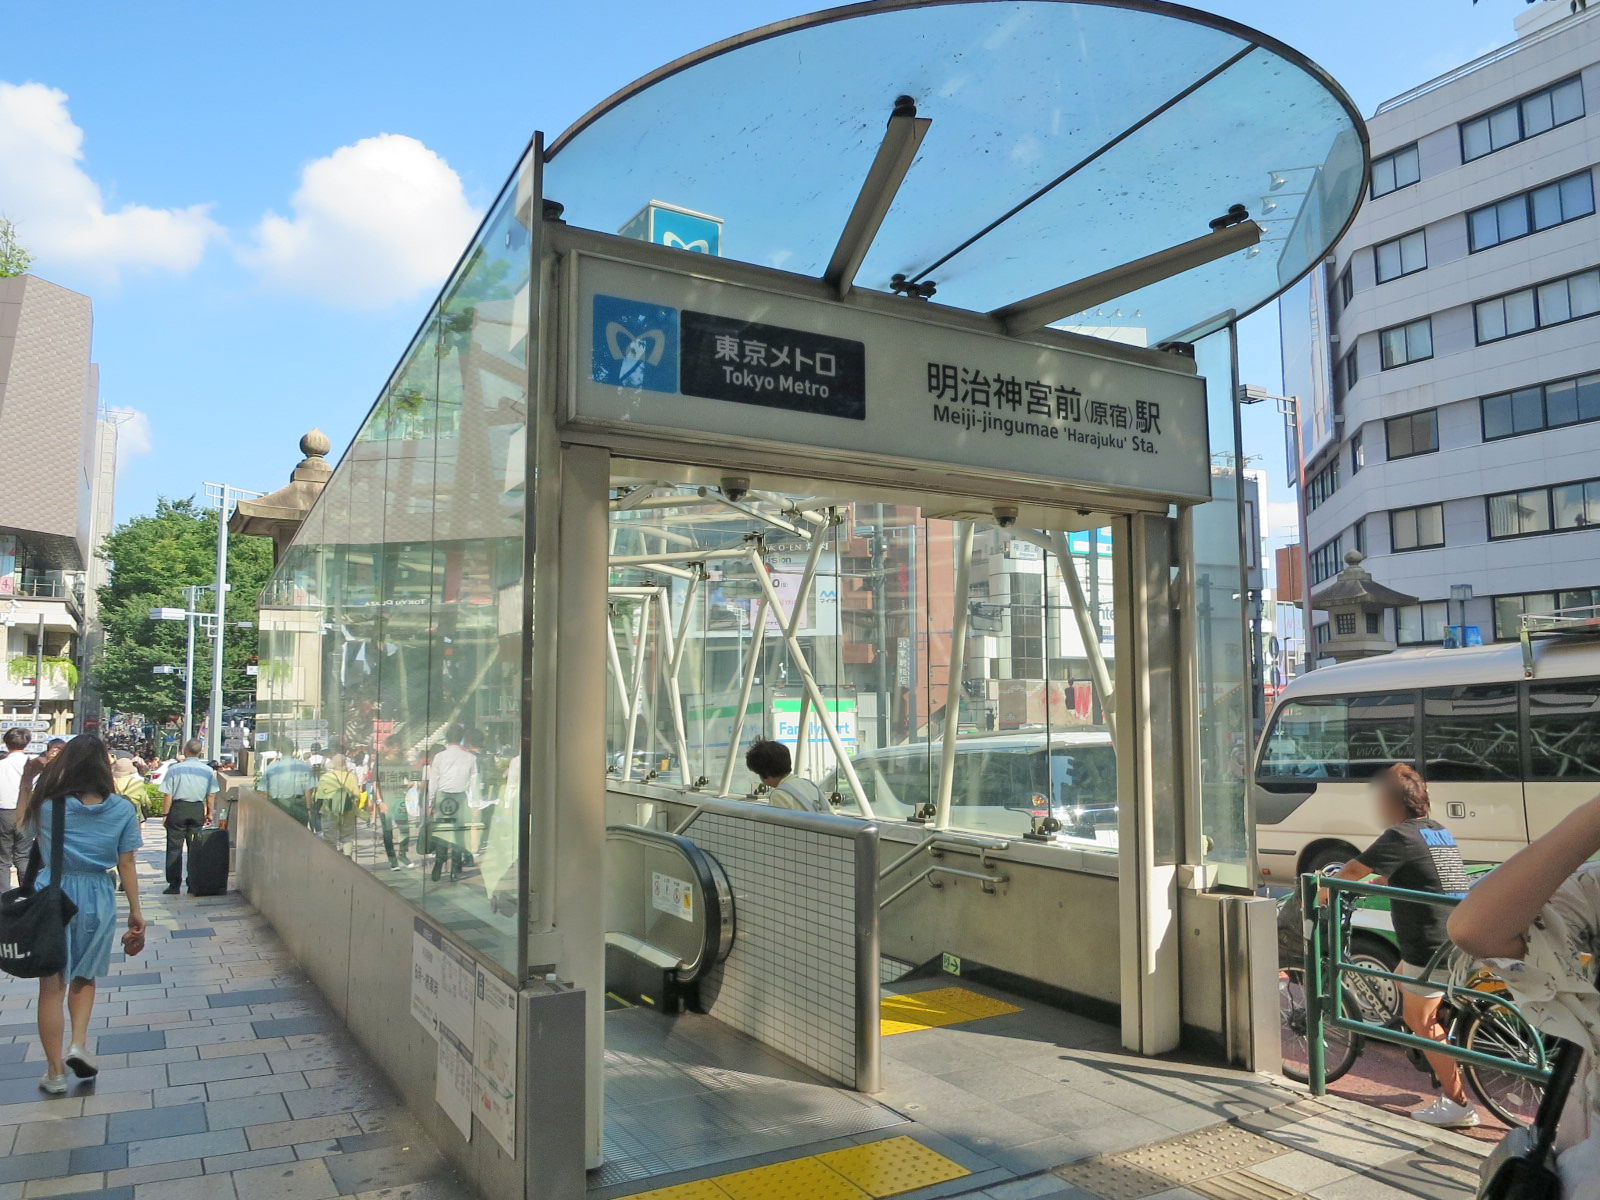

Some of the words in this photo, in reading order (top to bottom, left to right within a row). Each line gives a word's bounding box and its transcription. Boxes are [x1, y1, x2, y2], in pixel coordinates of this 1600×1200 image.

[714, 335, 836, 377] 東京メトロ
[722, 366, 775, 392] Tokyo
[779, 375, 830, 399] Metro
[933, 404, 1059, 439] Meiji-jingumae
[1063, 427, 1128, 450] 'Harajuku'
[1132, 436, 1159, 455] Sta.
[779, 721, 850, 736] Falyrt
